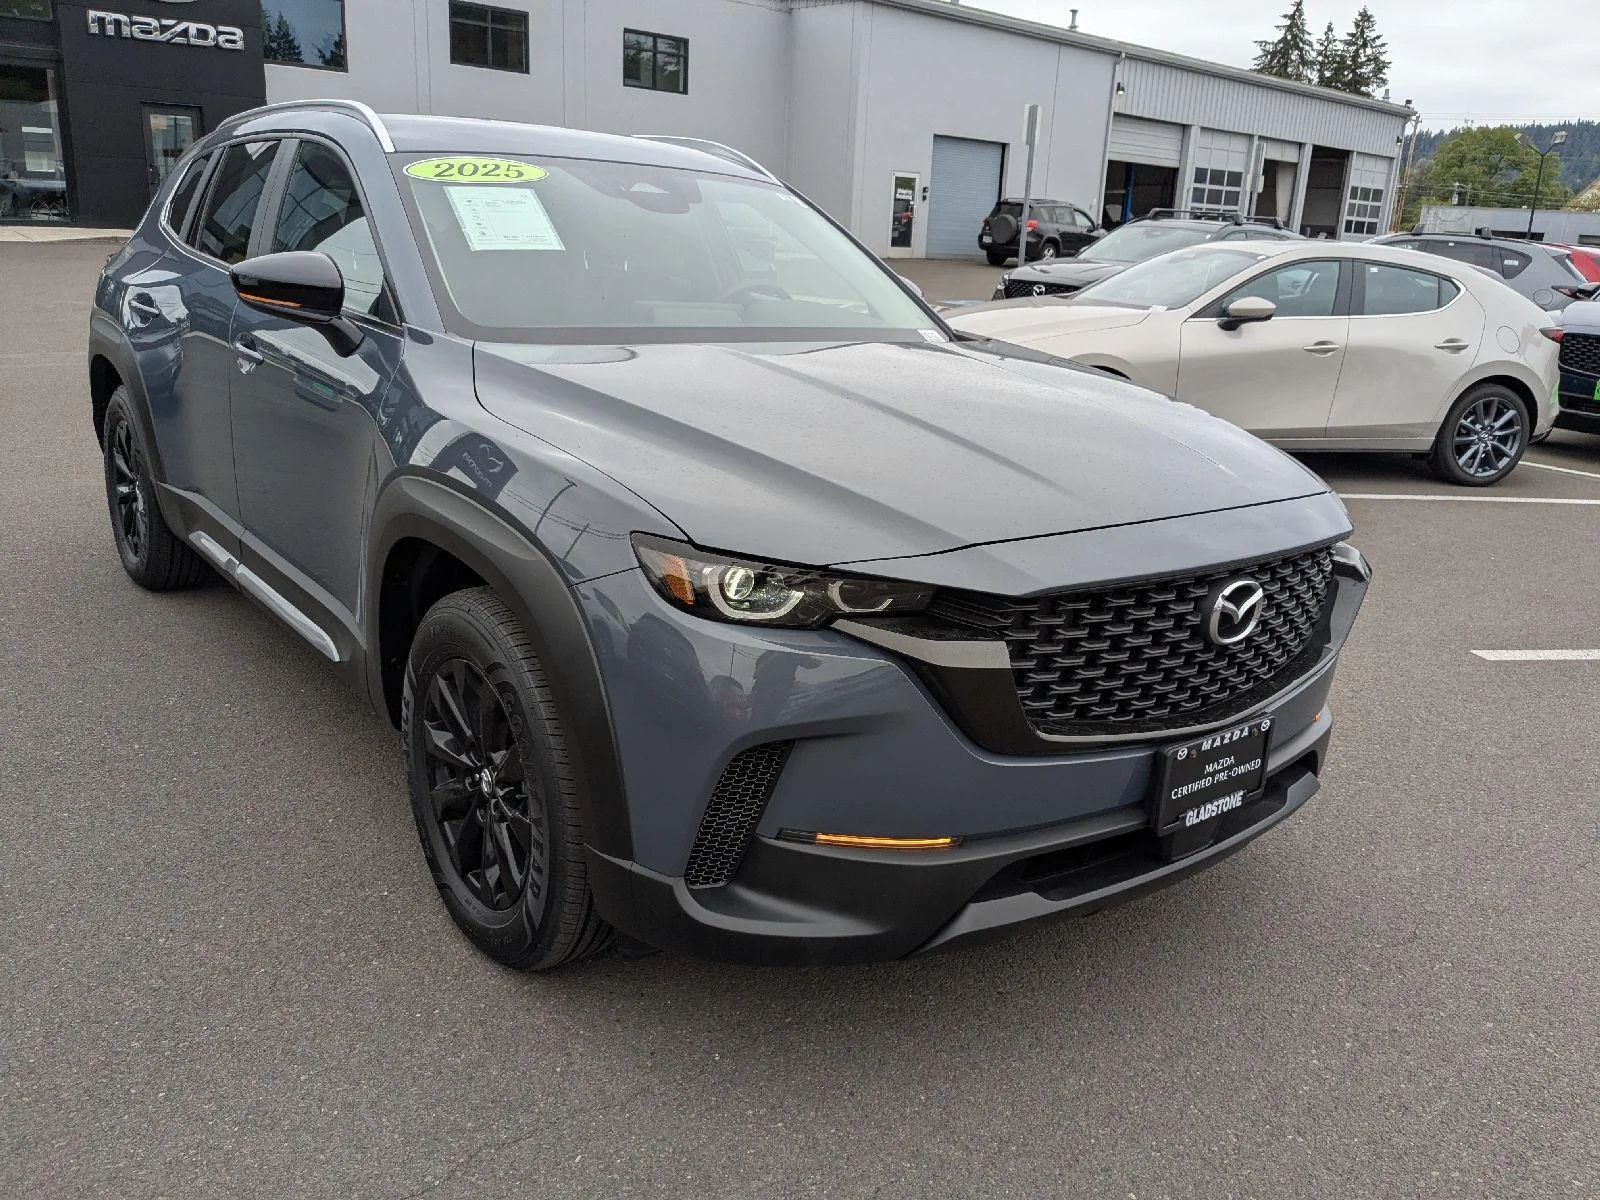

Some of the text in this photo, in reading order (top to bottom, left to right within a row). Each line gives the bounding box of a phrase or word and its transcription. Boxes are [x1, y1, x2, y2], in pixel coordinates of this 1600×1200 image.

[434, 162, 525, 179] 2025
[1201, 726, 1249, 751] MAZDA
[1204, 755, 1235, 774] MAZDA
[1171, 758, 1261, 800] CERTIFIED PRE-OWNED
[1185, 789, 1244, 827] GLADSTONE
